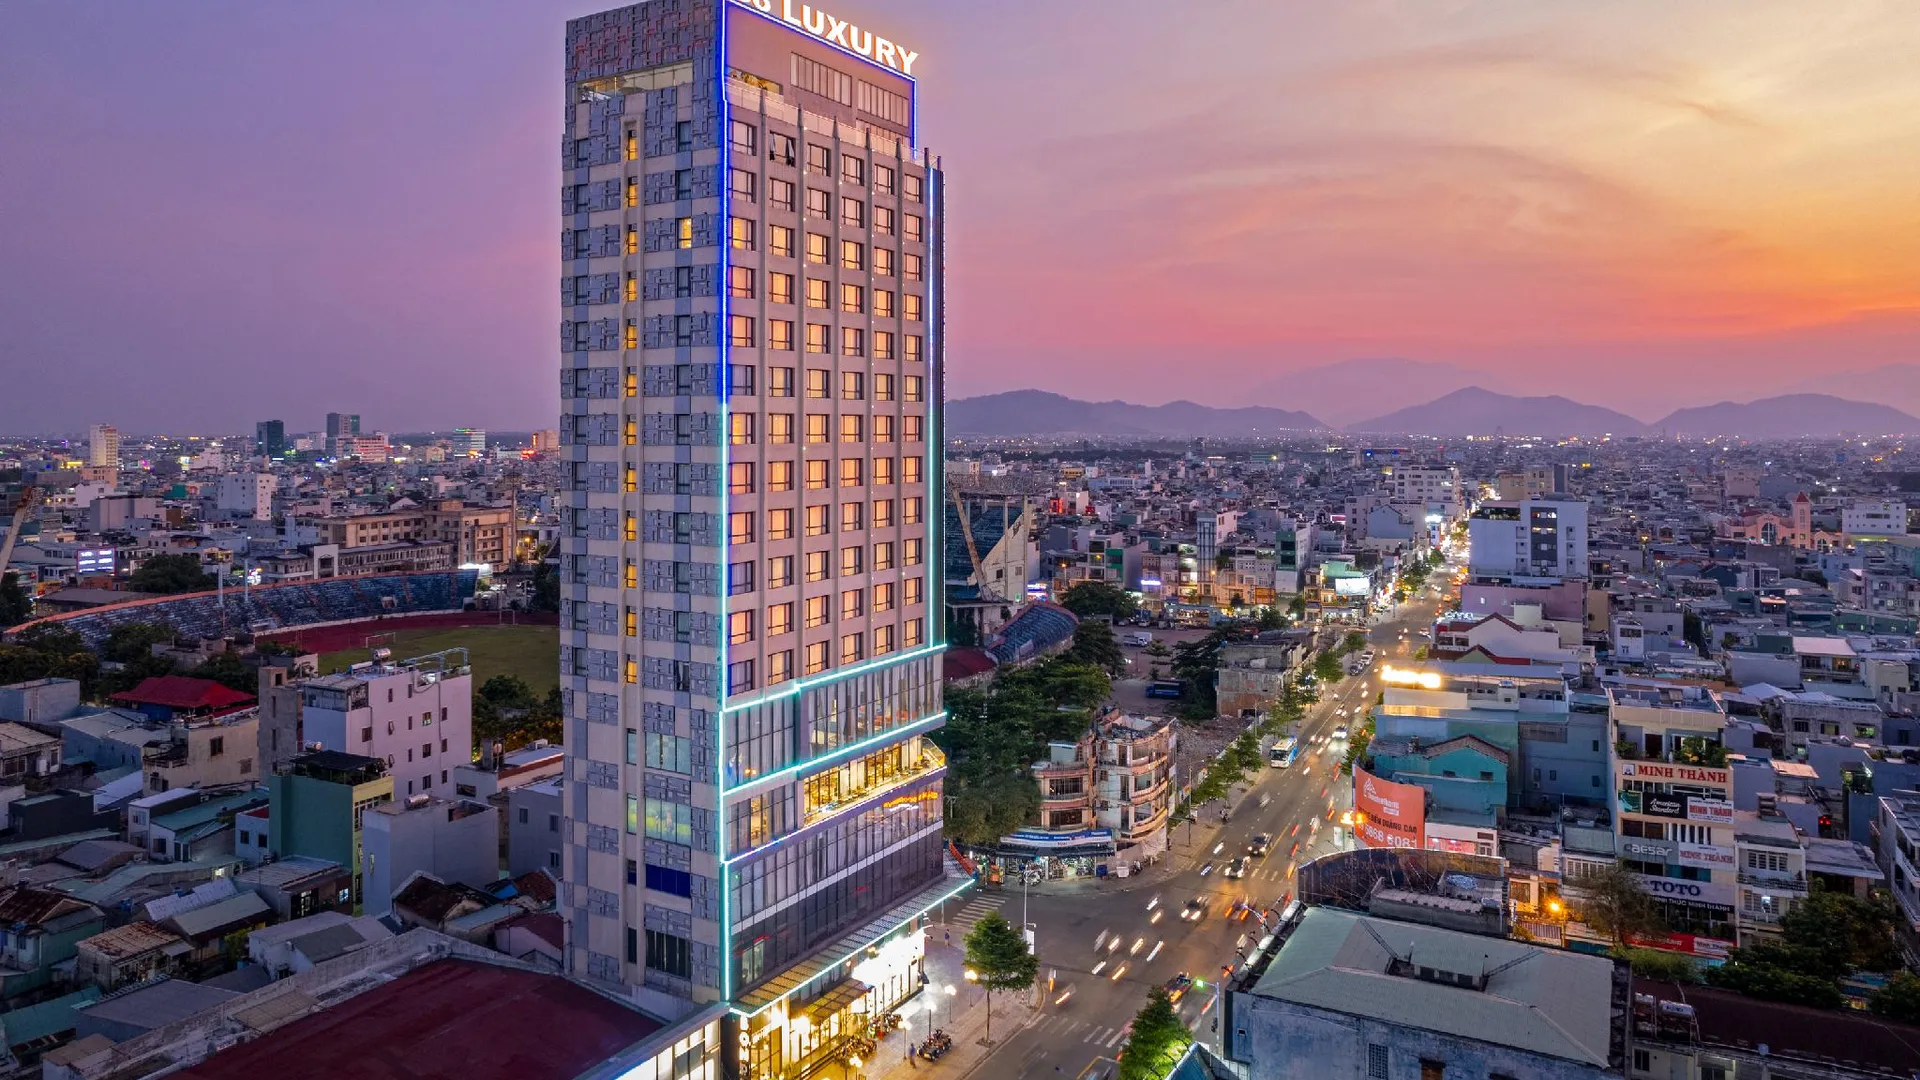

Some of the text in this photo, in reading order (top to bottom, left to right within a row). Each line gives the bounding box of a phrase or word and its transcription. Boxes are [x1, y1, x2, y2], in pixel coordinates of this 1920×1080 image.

[782, 0, 918, 74] LUXURY
[1638, 765, 1727, 783] MINH THÀNH
[1650, 798, 1681, 808] American
[1650, 805, 1680, 814] Standard
[1688, 804, 1708, 815] MINH
[1650, 880, 1701, 897] TOTO
